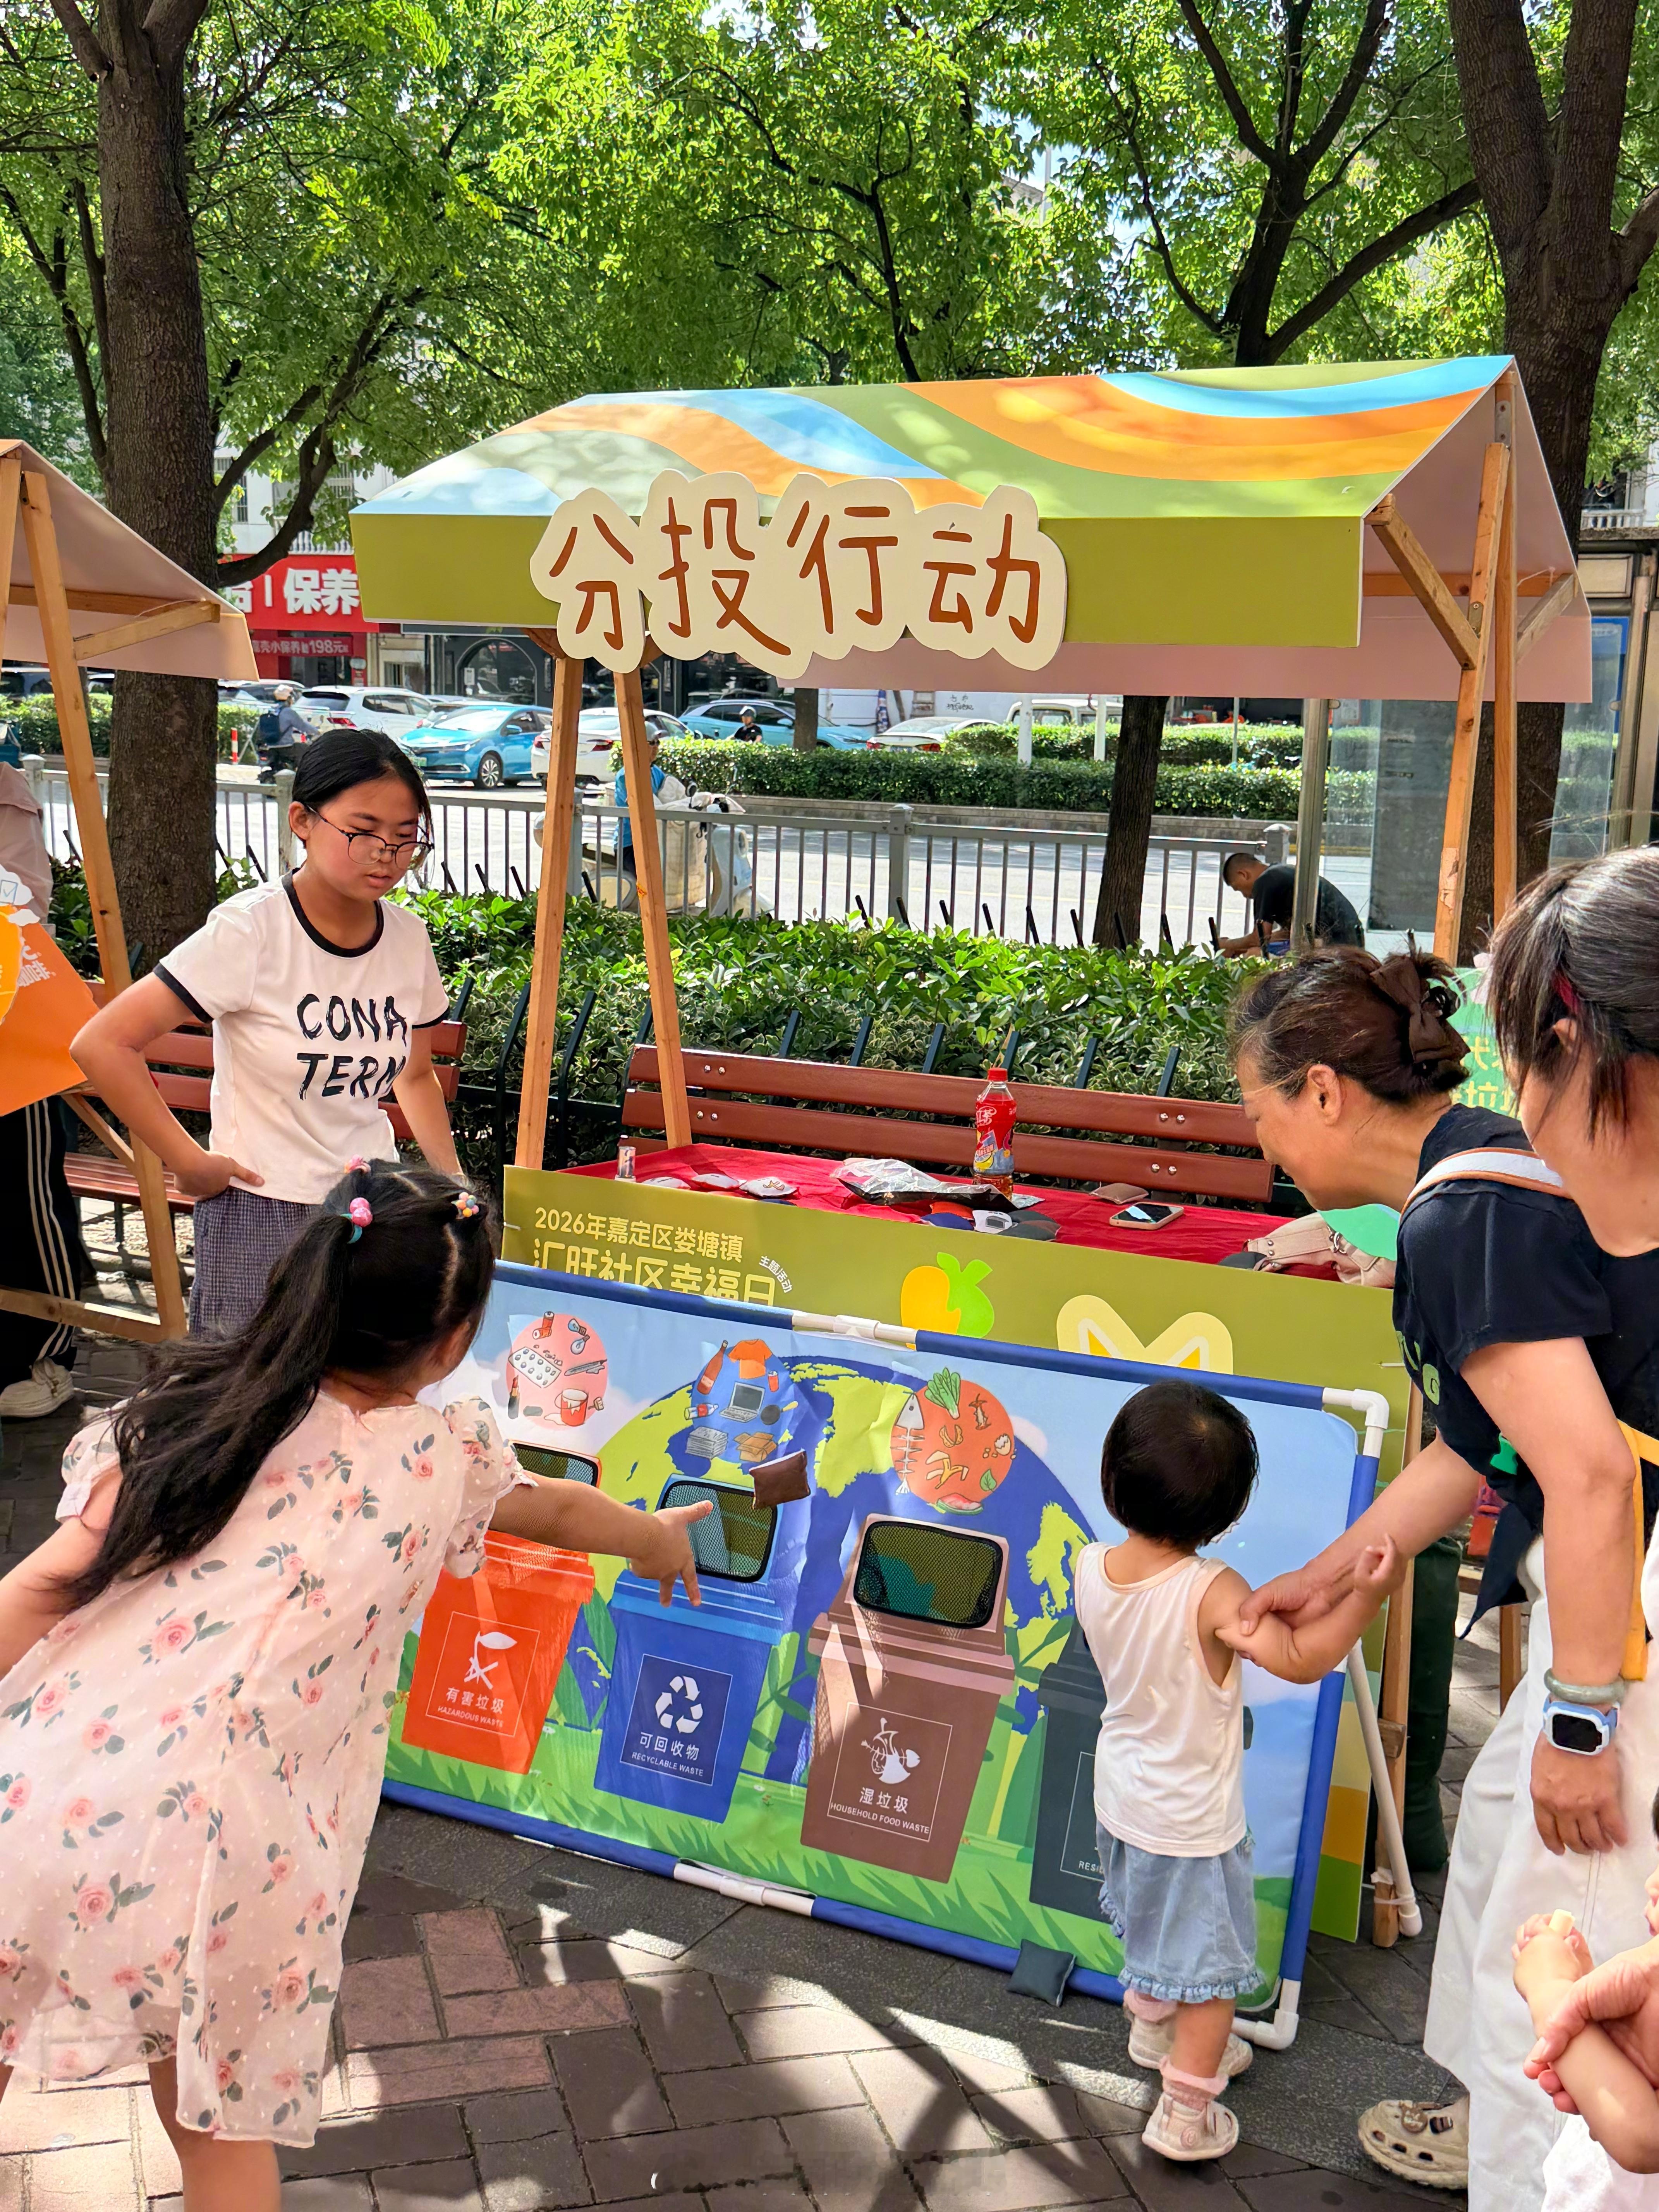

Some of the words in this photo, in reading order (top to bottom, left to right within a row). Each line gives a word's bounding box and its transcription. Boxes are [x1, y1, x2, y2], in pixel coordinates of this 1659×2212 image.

[283, 567, 359, 615] 保养
[549, 496, 1040, 656] 分投行动
[297, 993, 407, 1048] CONA
[535, 1207, 744, 1263] 2026年嘉定区娄塘镇
[759, 1255, 792, 1293] 主题活动
[438, 1705, 479, 1722] HAZARDOUS
[480, 1716, 504, 1728] WASTE
[446, 1687, 504, 1714] 有害垃圾
[640, 1732, 699, 1760] 可回收物
[632, 1752, 677, 1770] RECYCLABLE
[679, 1764, 704, 1776] WASTE
[859, 1787, 908, 1814] 湿垃圾
[830, 1802, 878, 1820] HOUSEHOLD
[879, 1815, 901, 1826] FOOD
[902, 1821, 930, 1834] WASTE
